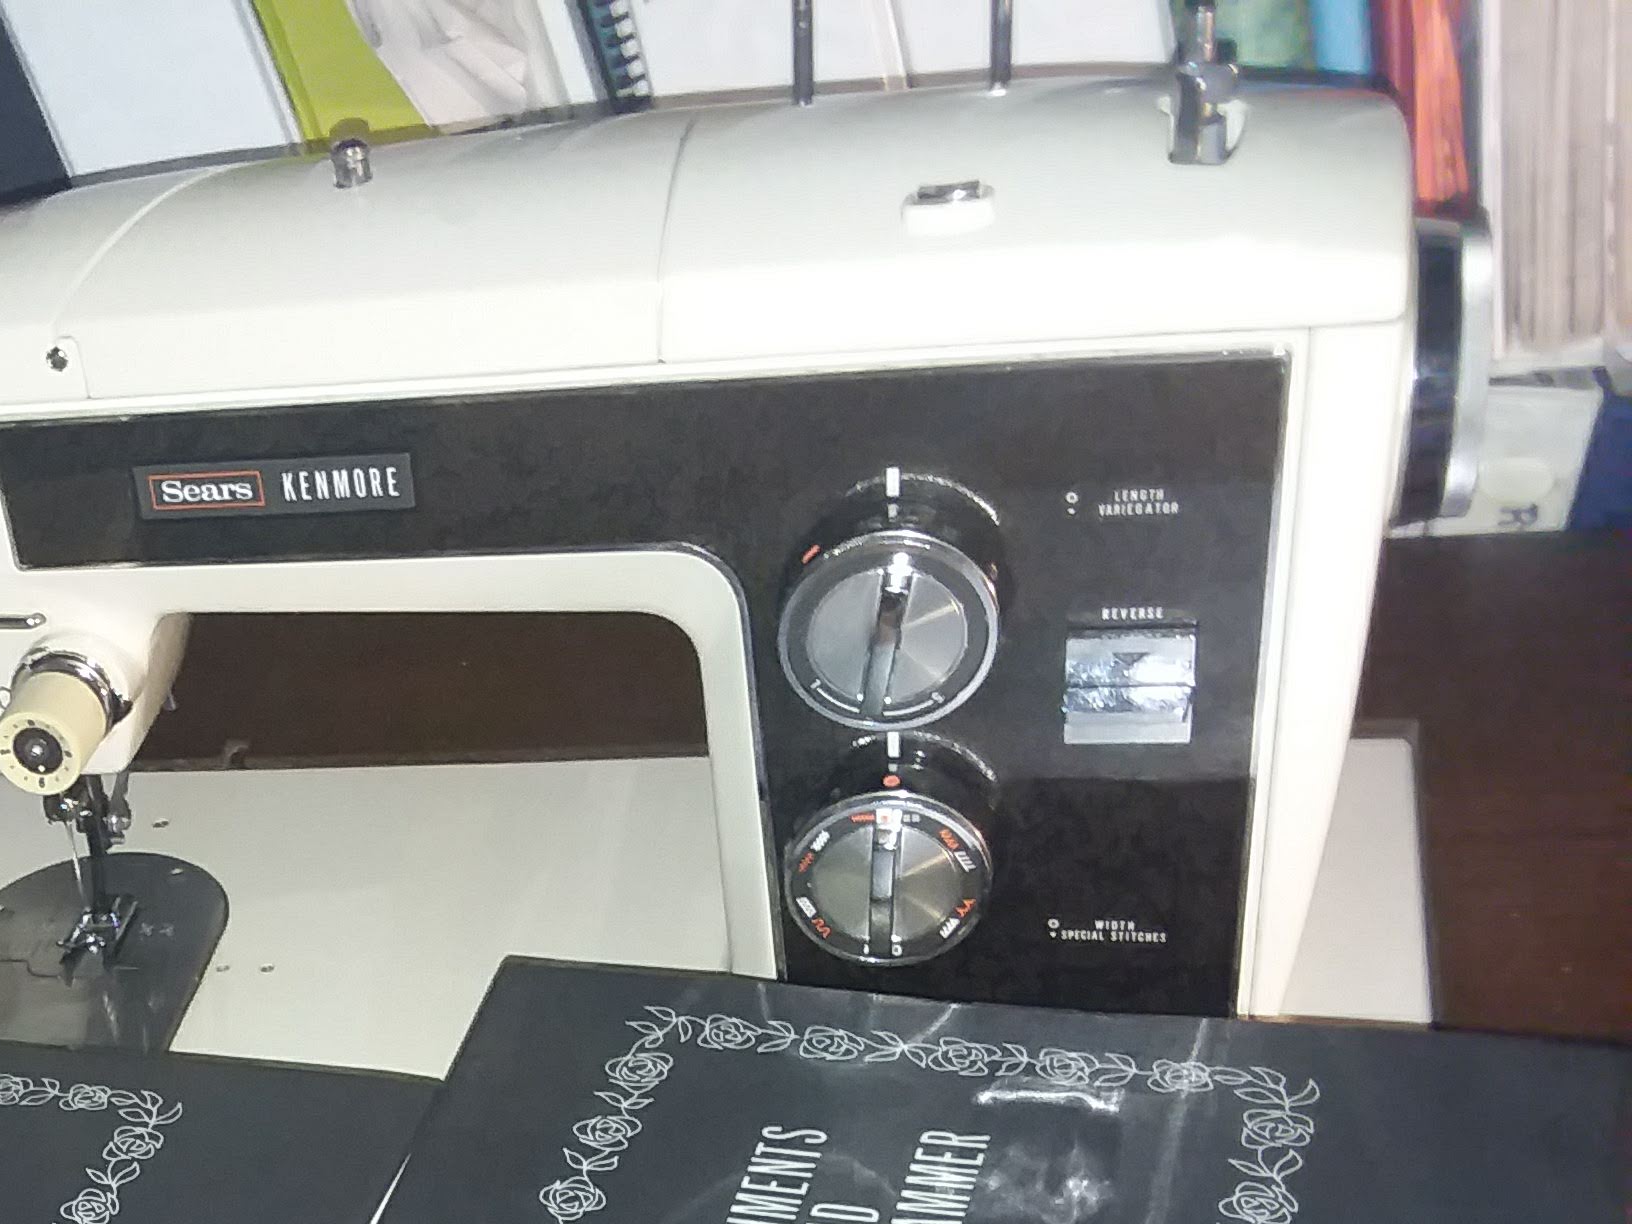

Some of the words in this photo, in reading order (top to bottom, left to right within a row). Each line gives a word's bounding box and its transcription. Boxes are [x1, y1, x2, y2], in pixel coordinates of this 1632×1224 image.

[161, 479, 253, 503] Sears
[280, 466, 401, 502] KENMORE
[1113, 488, 1165, 502] LENGTH
[1098, 502, 1180, 516] VARIEGATOR
[1101, 606, 1164, 620] REVERSE
[1094, 919, 1136, 931] WIDTH
[1060, 930, 1105, 941] SPECIAL
[1111, 930, 1167, 943] STITCHES
